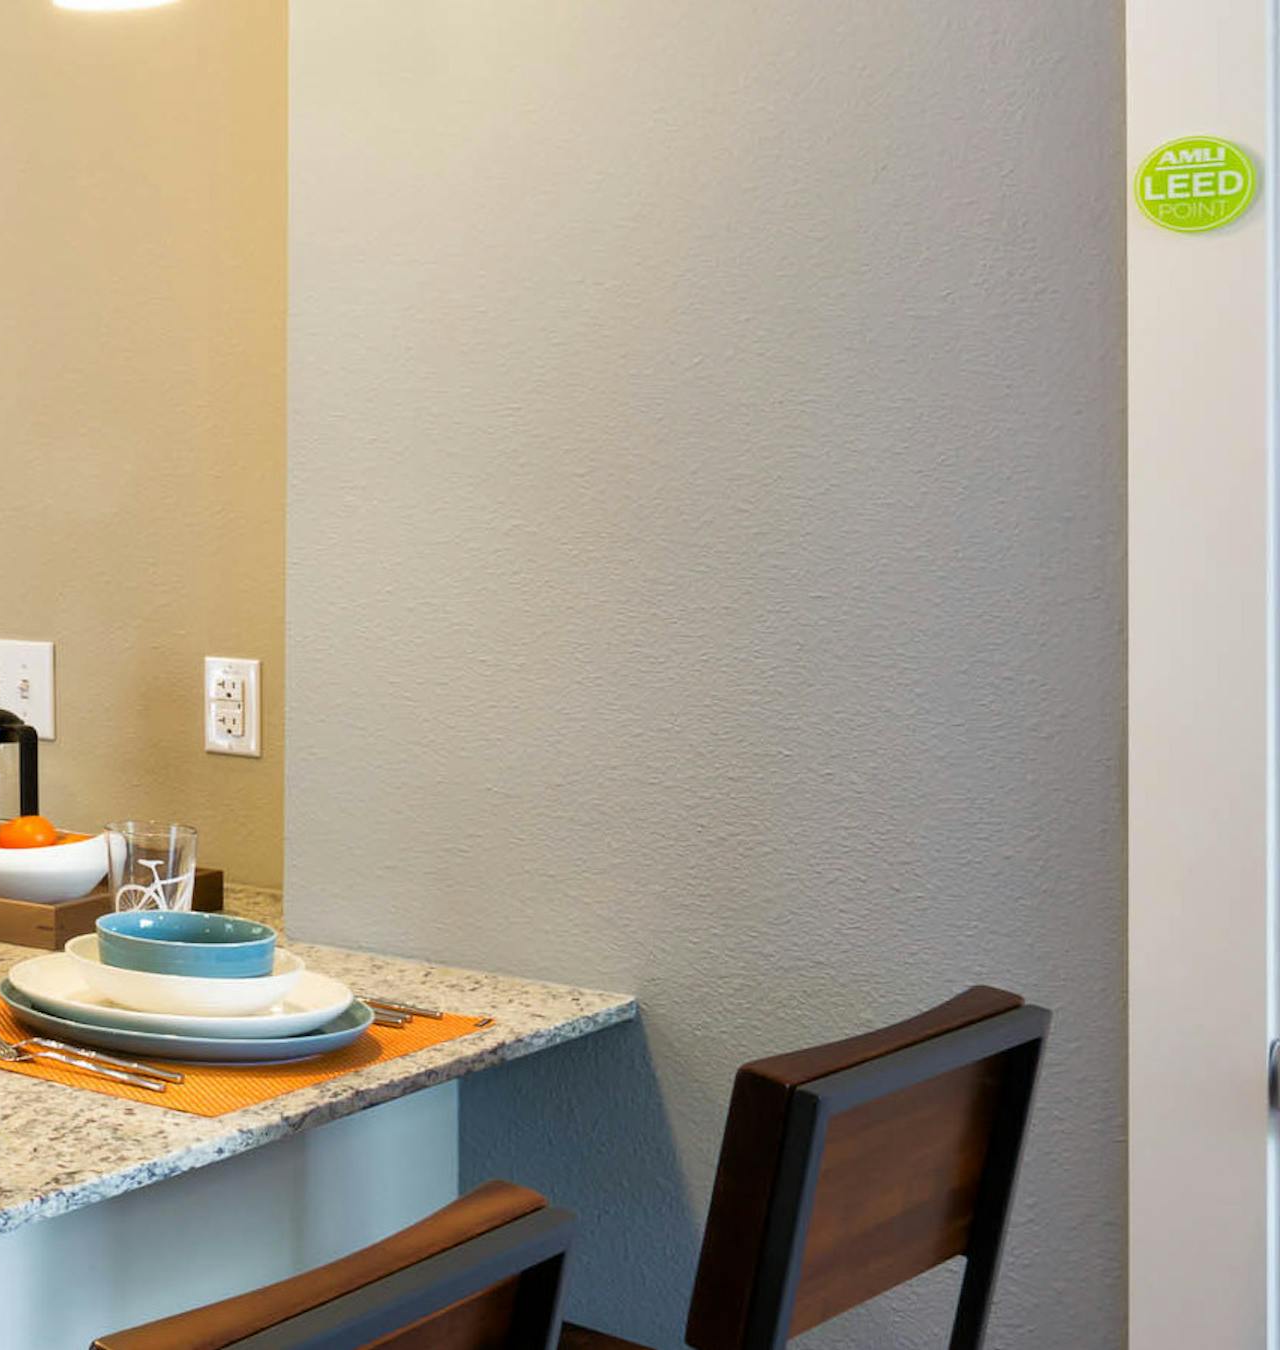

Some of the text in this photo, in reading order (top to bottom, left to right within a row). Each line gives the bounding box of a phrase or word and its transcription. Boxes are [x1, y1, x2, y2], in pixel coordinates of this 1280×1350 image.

[1159, 147, 1225, 165] AMLI
[1144, 170, 1243, 200] LEED
[1158, 201, 1227, 219] POINT
